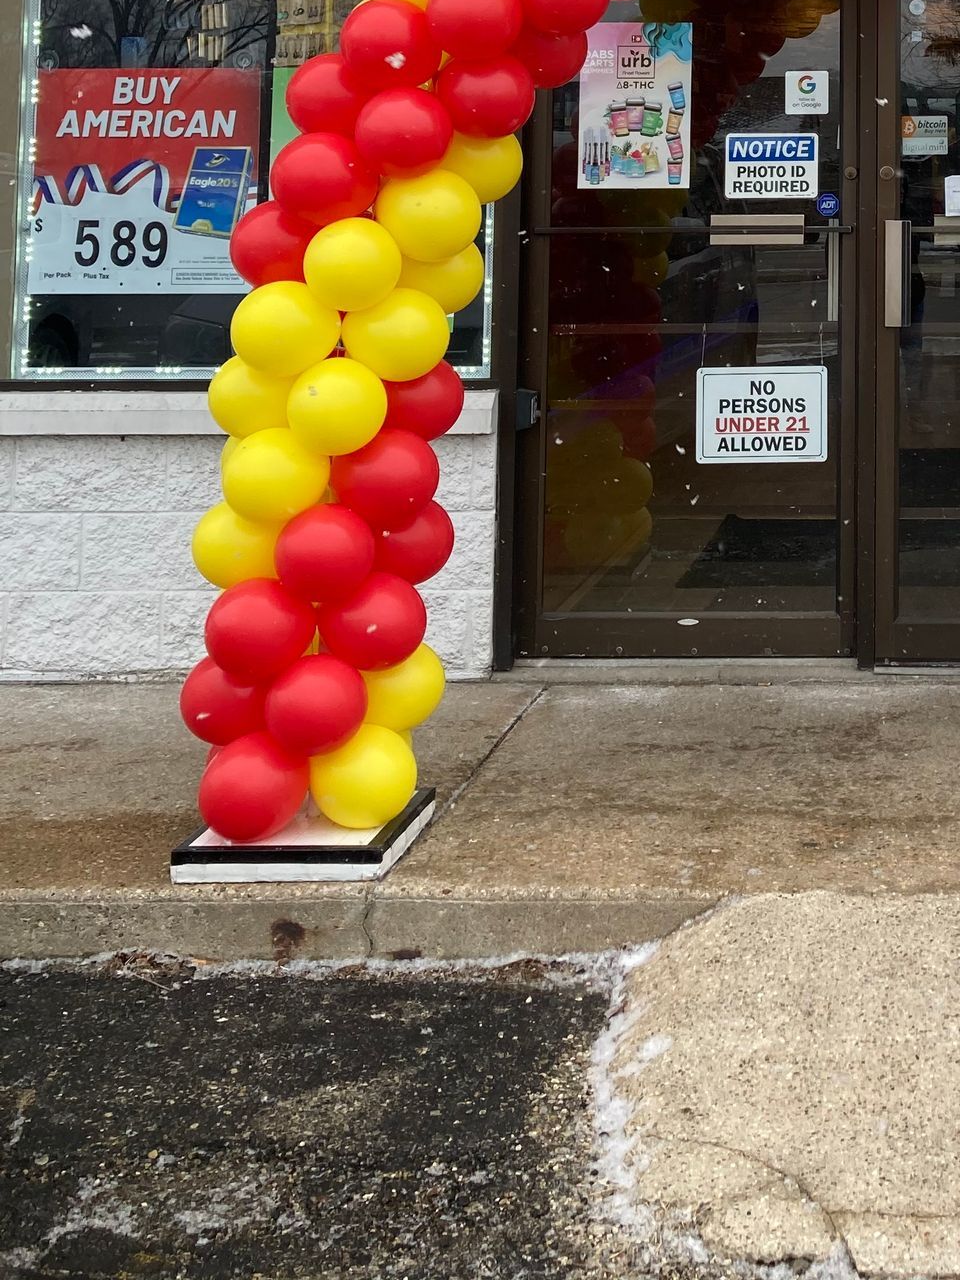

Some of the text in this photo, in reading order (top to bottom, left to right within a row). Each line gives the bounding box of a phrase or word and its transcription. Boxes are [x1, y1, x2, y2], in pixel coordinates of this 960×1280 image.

[621, 53, 652, 68] urb
[112, 76, 181, 105] BUY
[800, 101, 822, 109] Google
[55, 109, 237, 138] AMERICAN
[917, 120, 947, 129] bitcoin
[732, 140, 811, 158] NOTICE
[737, 165, 806, 178] PHOTO ID
[733, 180, 810, 195] REQUIRED
[820, 200, 836, 209] ADT
[34, 218, 43, 234] $
[56, 271, 72, 279] Pack
[98, 272, 110, 280] Tax
[750, 380, 776, 396] NO
[719, 397, 807, 414] PERSONS
[715, 415, 811, 433] UNDER 21
[717, 436, 808, 452] ALLOWED
